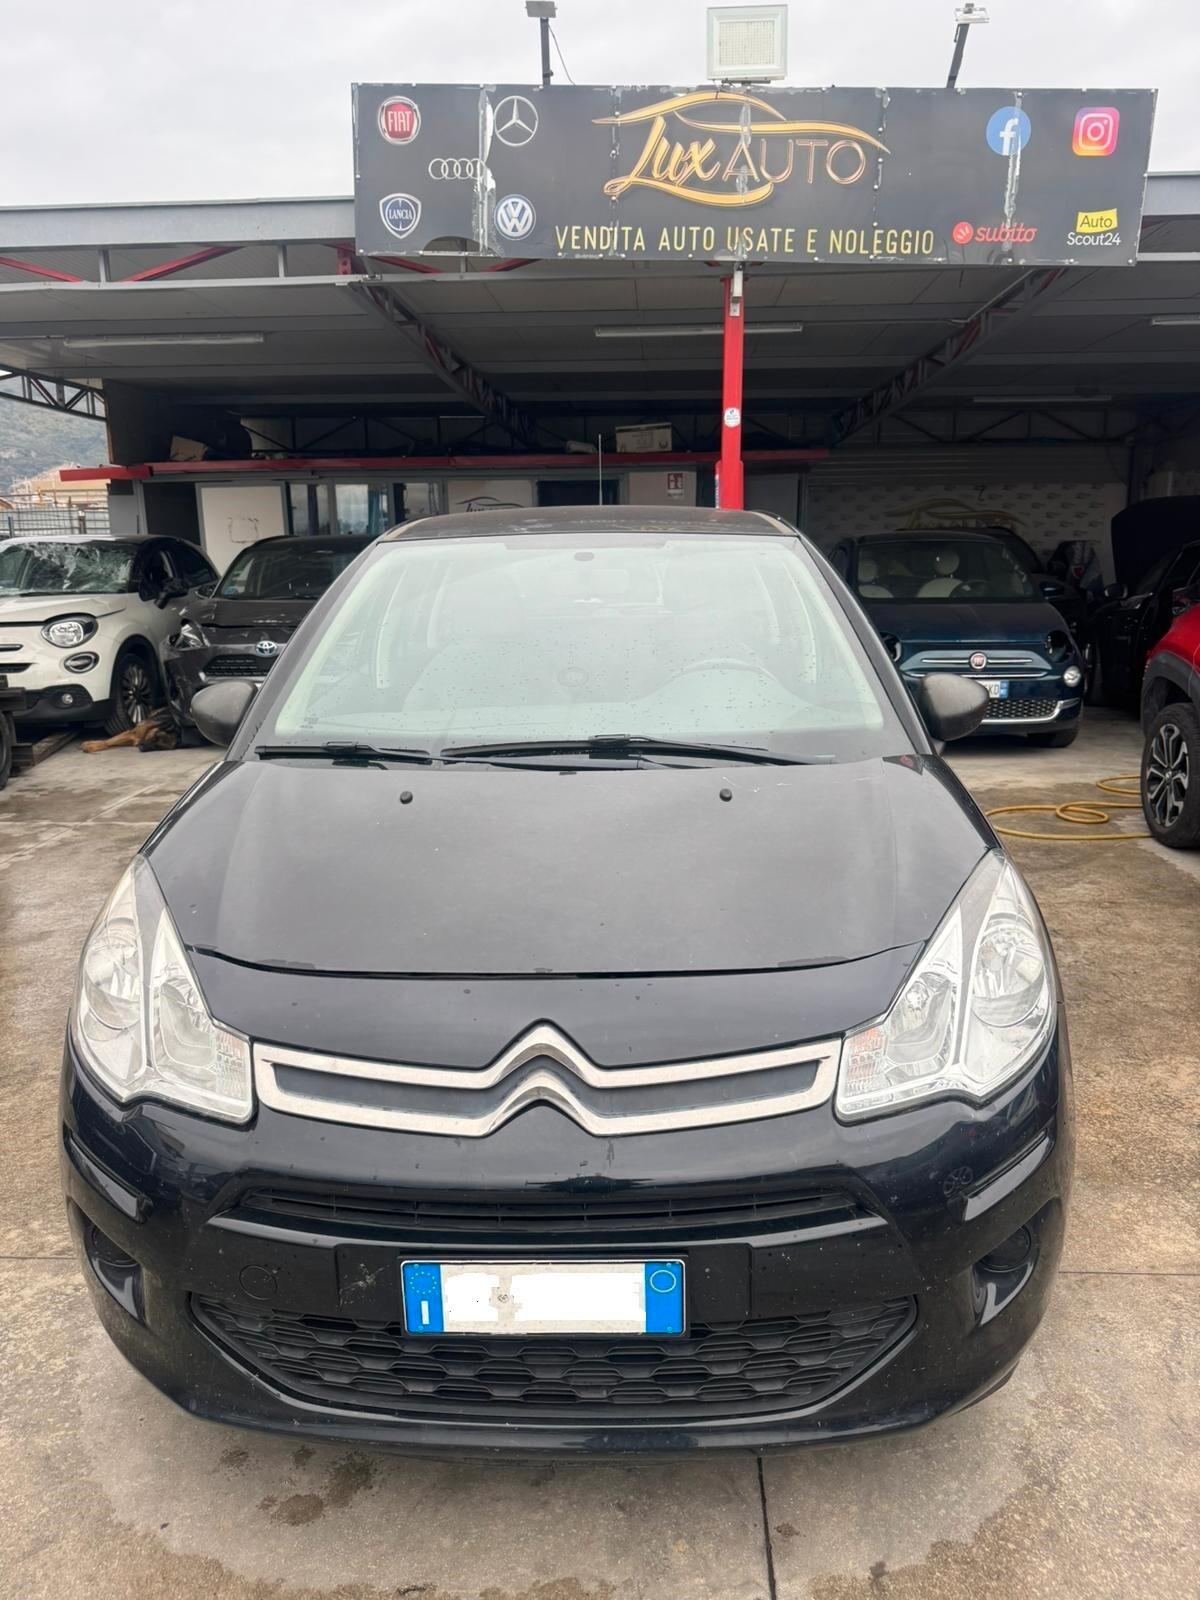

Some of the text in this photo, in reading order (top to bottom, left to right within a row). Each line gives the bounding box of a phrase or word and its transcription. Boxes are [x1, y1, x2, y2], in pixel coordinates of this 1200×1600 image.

[387, 110, 412, 132] FIAT
[604, 115, 866, 196] Lux AUTO
[388, 208, 413, 220] LANCIA
[1079, 215, 1113, 228] Auto
[555, 225, 934, 254] VENDITA AUTO USATE E NOLEGGIO
[974, 223, 1038, 243] subito
[1066, 231, 1122, 246] Scout24
